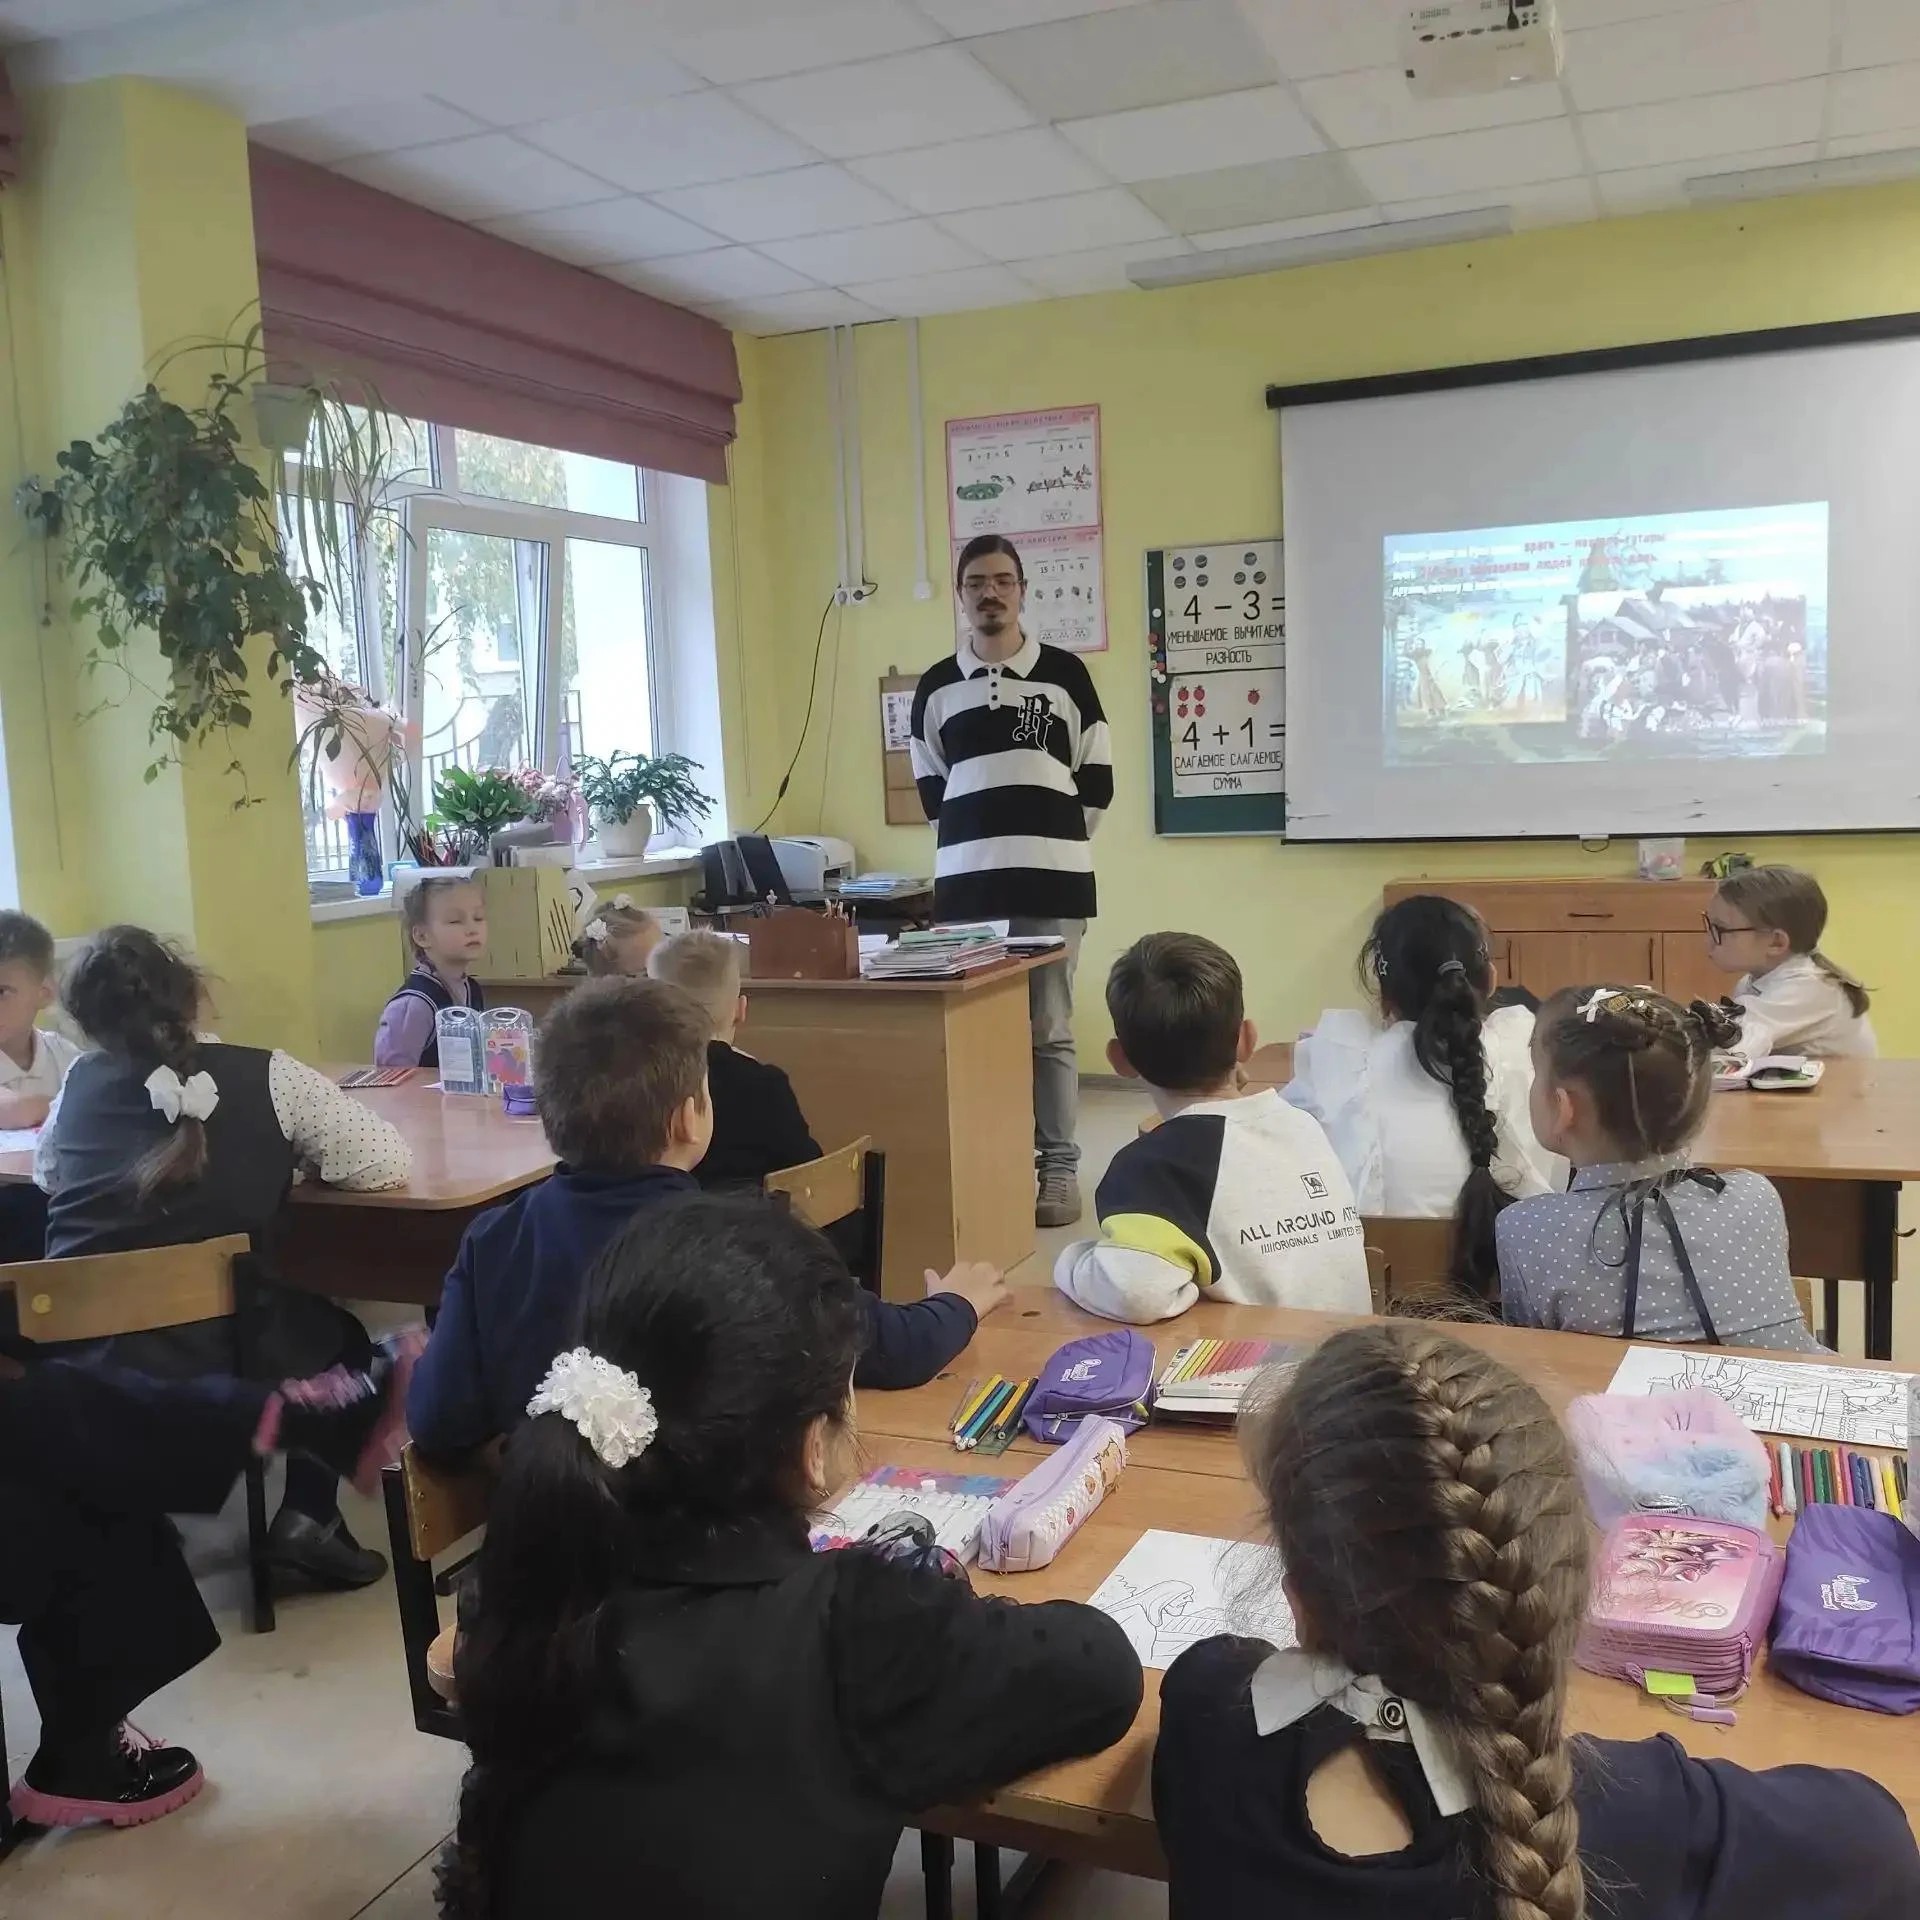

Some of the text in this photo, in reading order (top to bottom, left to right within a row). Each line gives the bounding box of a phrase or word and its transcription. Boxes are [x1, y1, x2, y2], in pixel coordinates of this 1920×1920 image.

[1183, 594, 1202, 624] 4
[1243, 590, 1260, 620] 3
[1168, 627, 1228, 644] УМЕНЬШАЕМОЕ
[1206, 650, 1252, 665] РАЗНОСТЬ
[1182, 721, 1201, 751] 4
[1212, 725, 1230, 746] +
[1240, 717, 1253, 748] 1
[1175, 750, 1281, 769] СЛАГАЕМОЕ СЛАГАЕМОЕ
[1213, 777, 1242, 790] СУММА
[1240, 1224, 1271, 1245] ALL
[1276, 1210, 1336, 1235] AROUND
[1327, 1226, 1355, 1240] LIMITED
